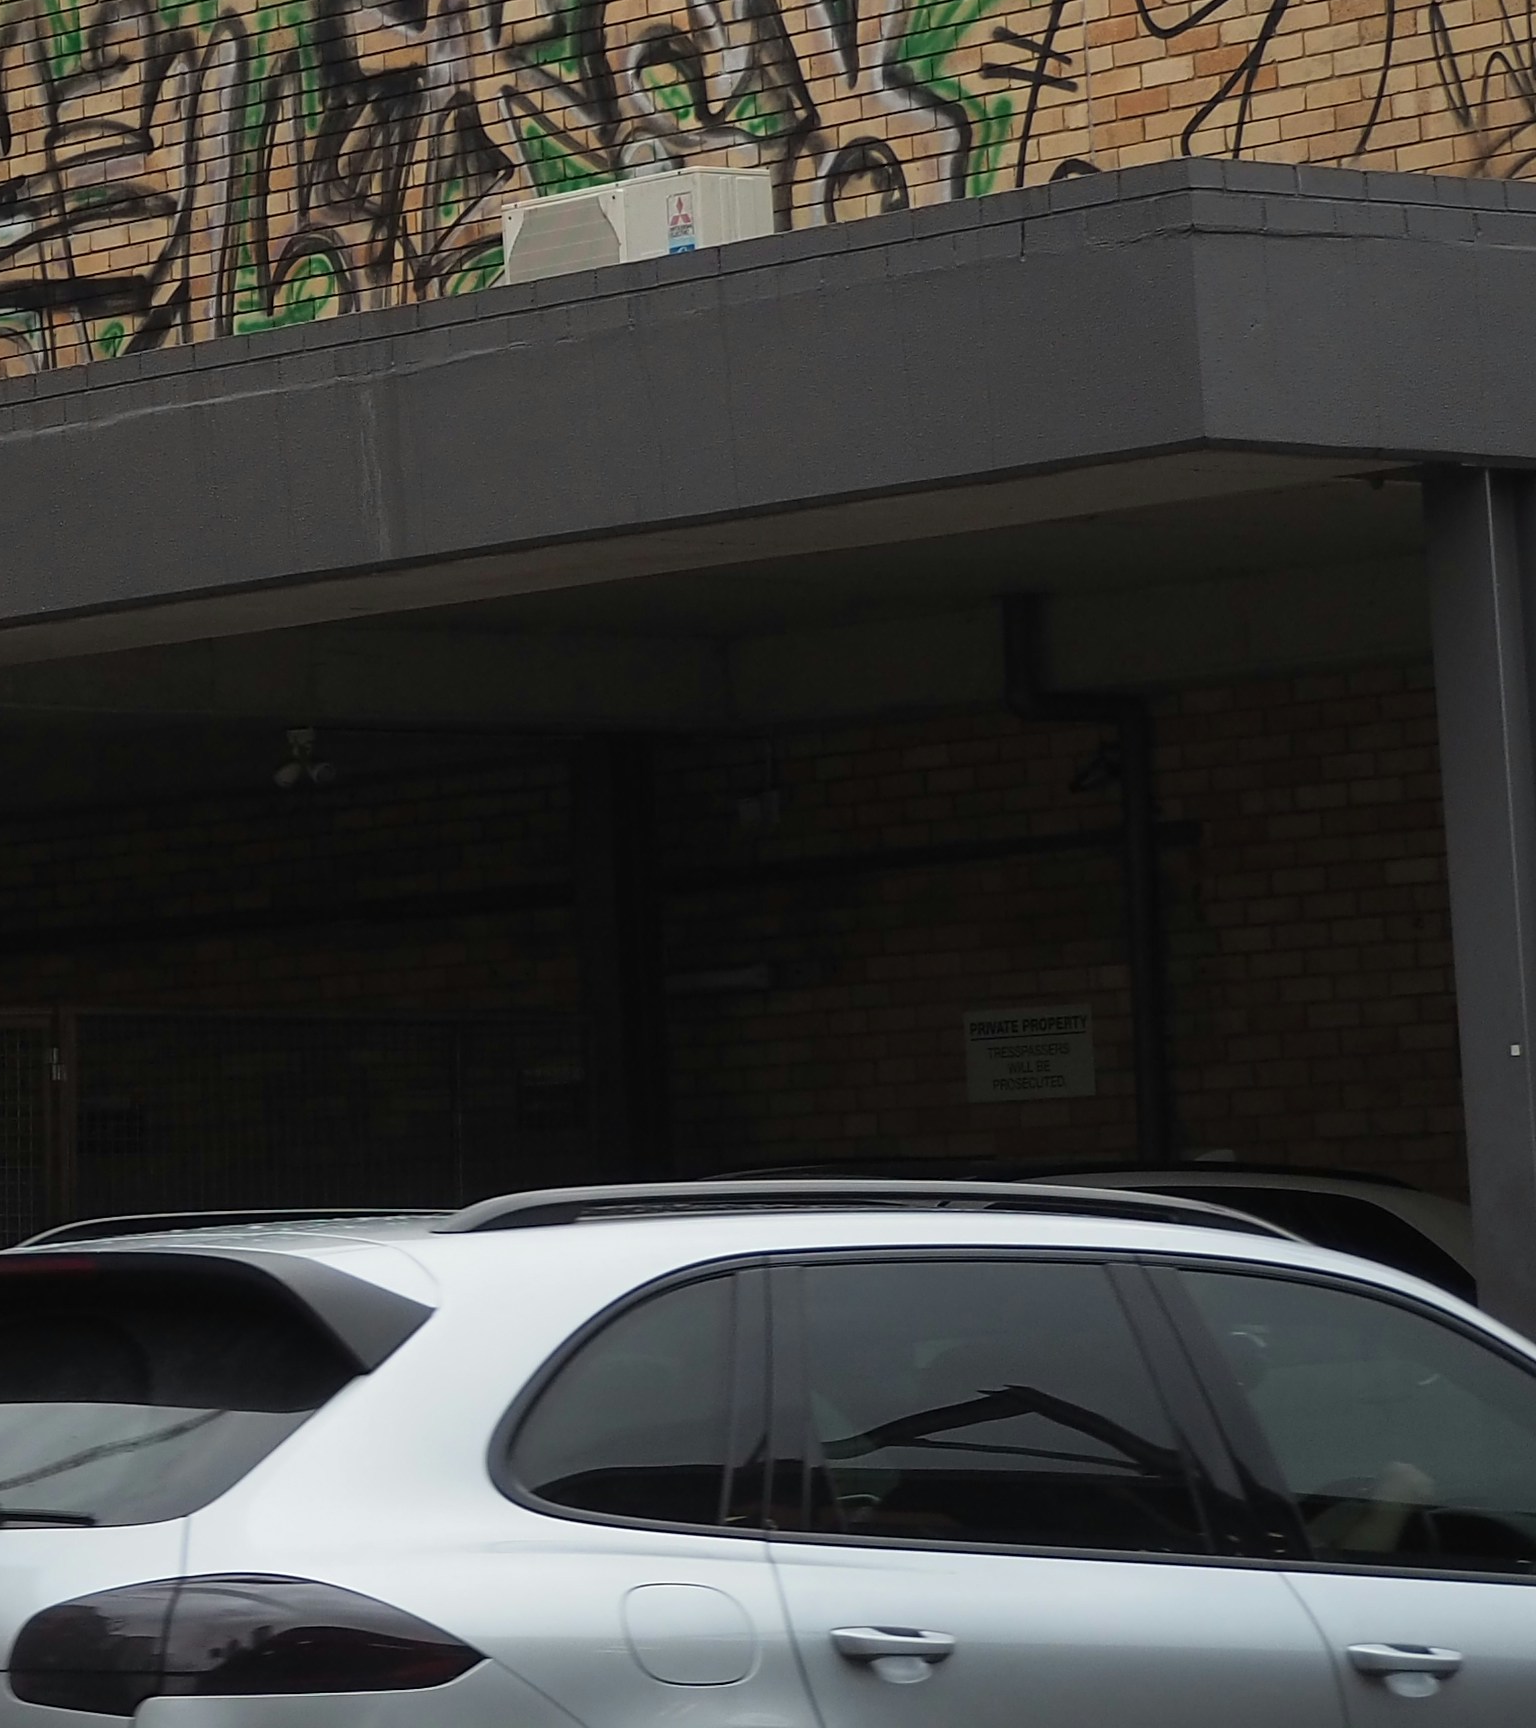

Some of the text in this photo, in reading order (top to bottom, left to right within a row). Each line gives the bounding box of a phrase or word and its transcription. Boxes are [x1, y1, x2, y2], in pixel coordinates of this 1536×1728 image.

[969, 1015, 1087, 1035] PRIVATE PROPERTY
[1009, 1060, 1050, 1073] WILL BE
[993, 1075, 1066, 1090] PROSECUTED
